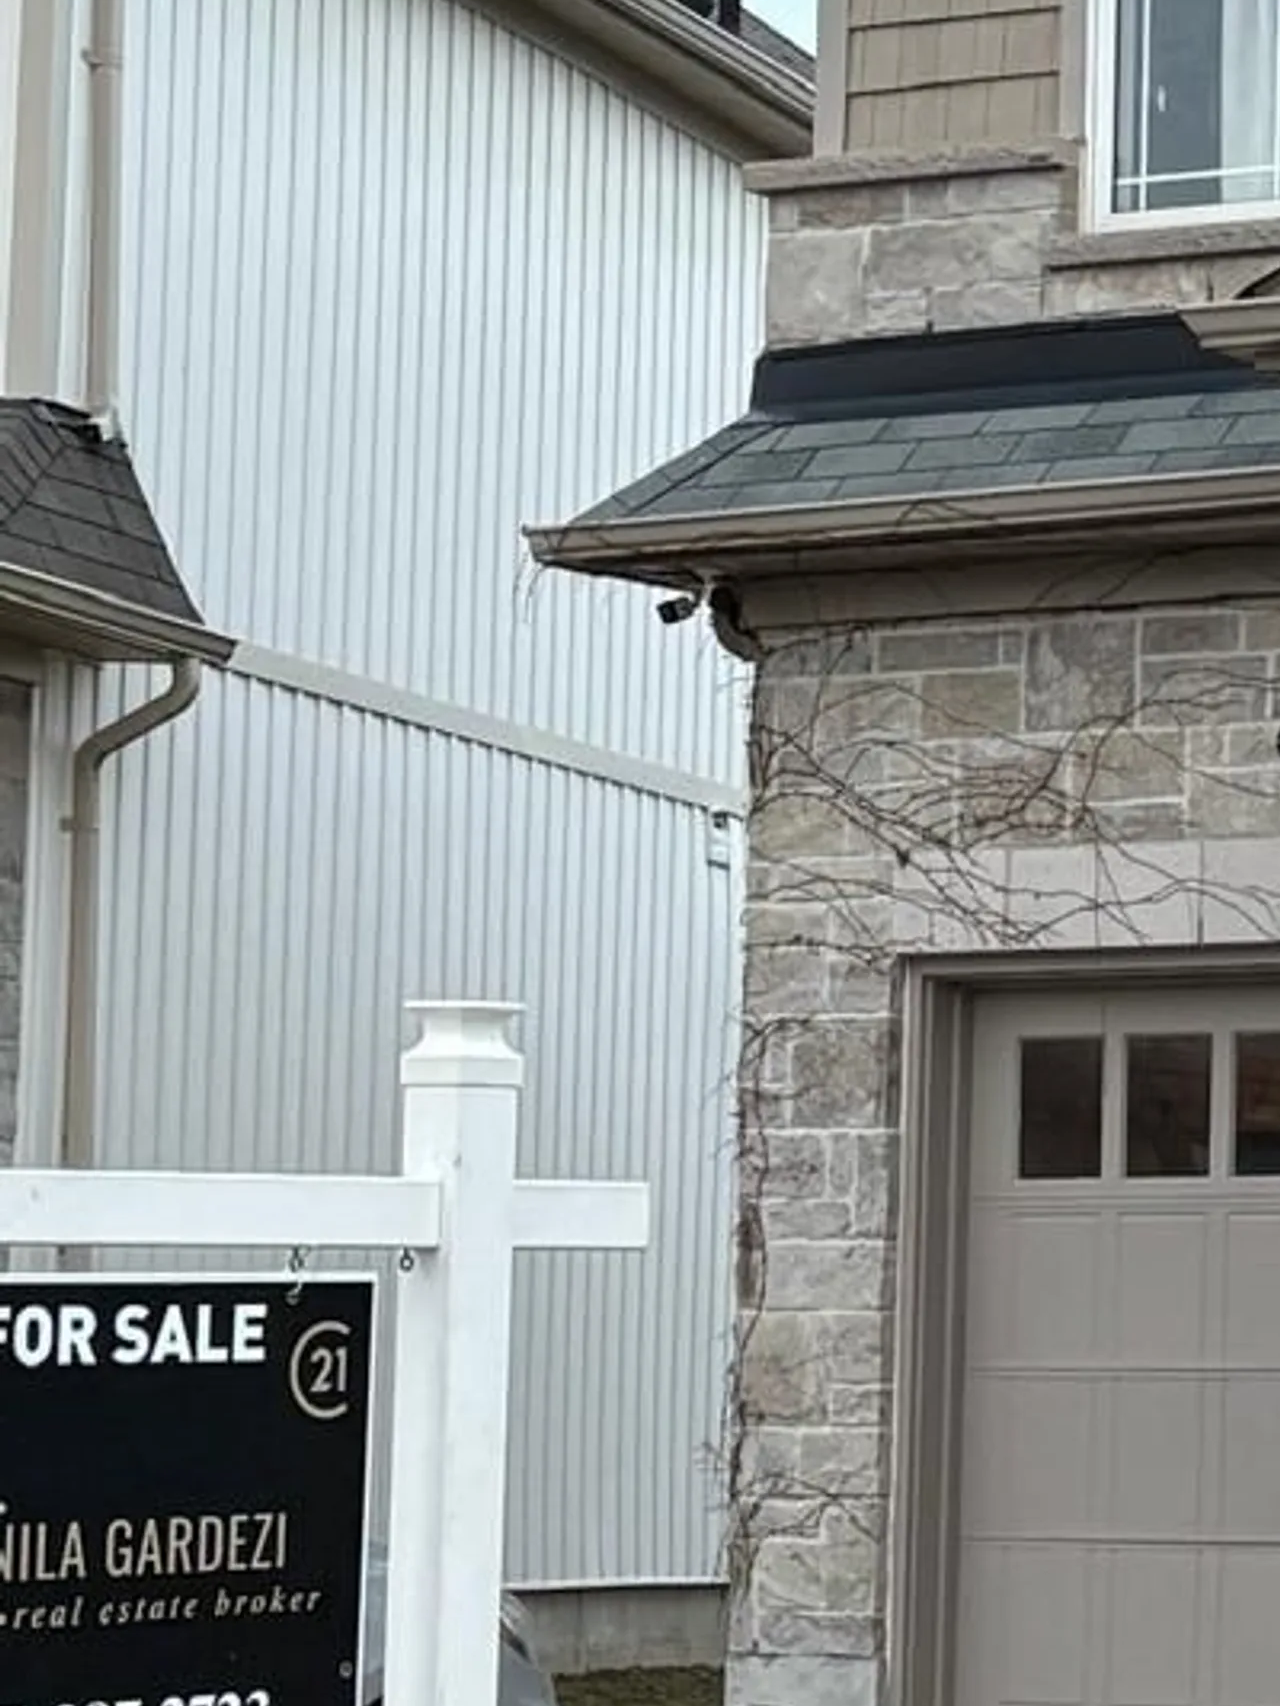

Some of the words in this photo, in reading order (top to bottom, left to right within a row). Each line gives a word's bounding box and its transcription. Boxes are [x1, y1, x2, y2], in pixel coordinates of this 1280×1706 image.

[111, 1303, 268, 1365] SALE
[105, 1511, 288, 1578] GARDEZI
[12, 1595, 84, 1630] real
[99, 1593, 198, 1626] estate
[214, 1587, 322, 1617] broker
